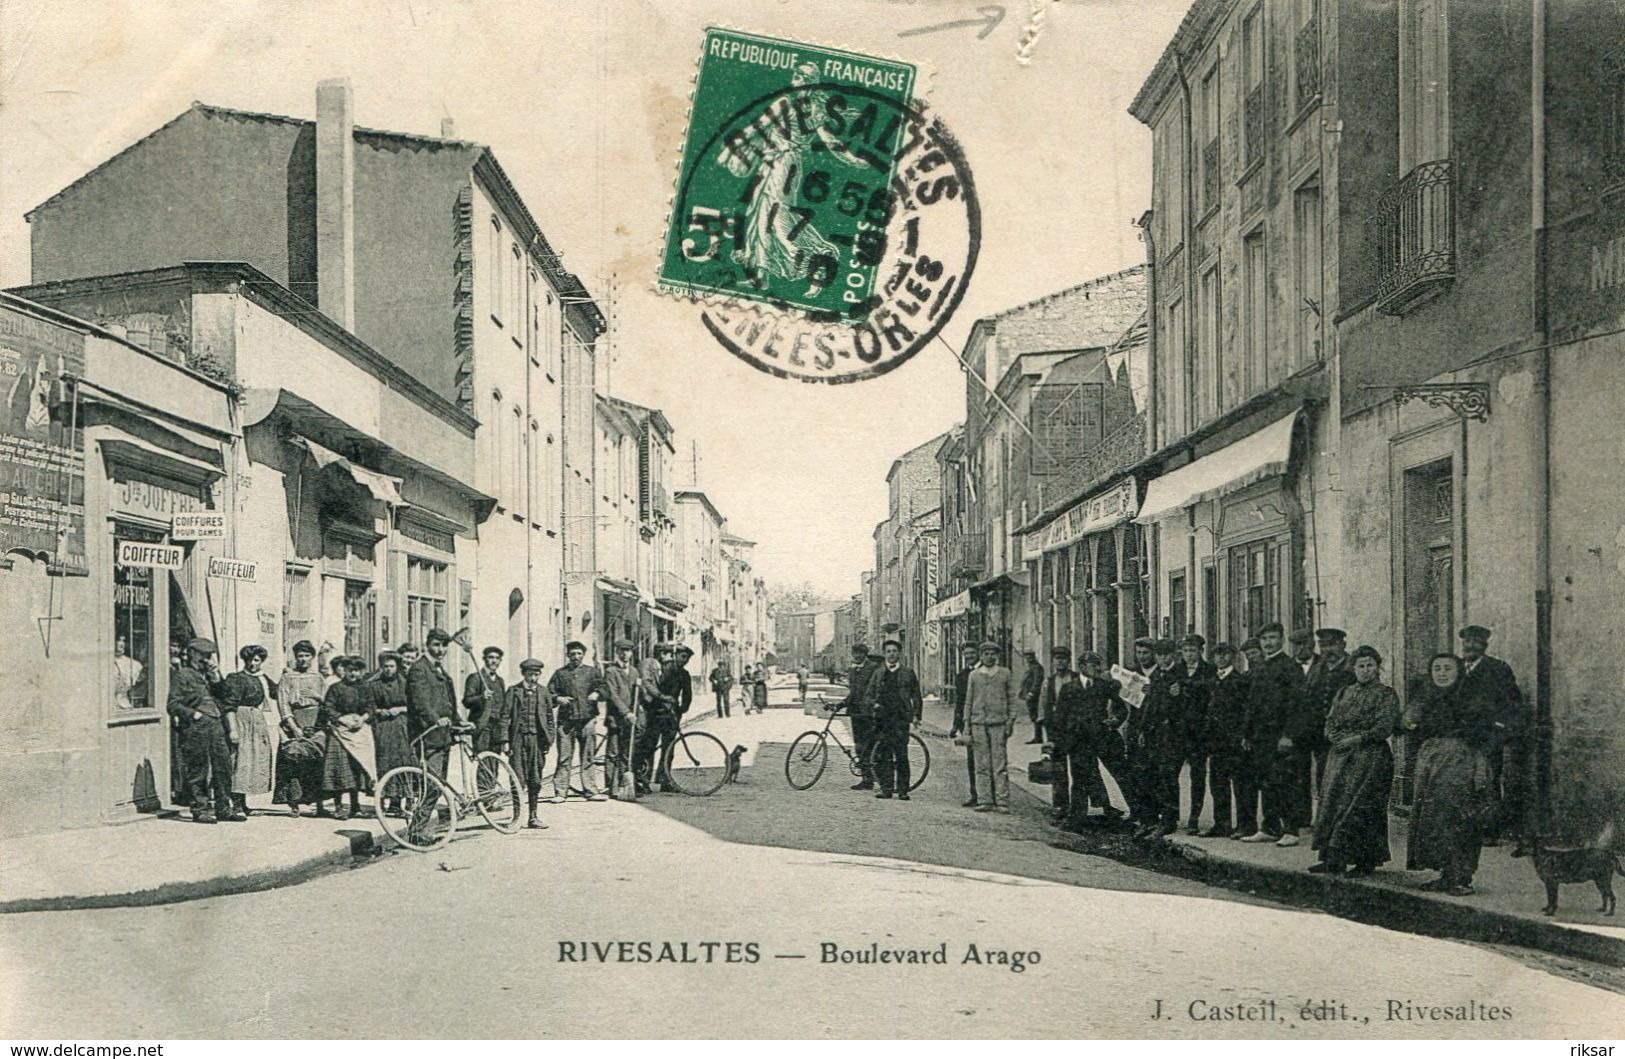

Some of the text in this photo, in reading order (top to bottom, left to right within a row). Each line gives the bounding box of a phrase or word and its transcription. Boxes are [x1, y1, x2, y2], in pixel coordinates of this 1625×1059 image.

[709, 37, 906, 91] REPUBLIQUE FRANÇAISE
[175, 516, 223, 527] COIFFURES
[175, 529, 223, 537] POUR DAMES
[122, 545, 179, 566] COIFFEUR
[928, 539, 938, 587] MARTY
[211, 558, 256, 579] COIFFEUR
